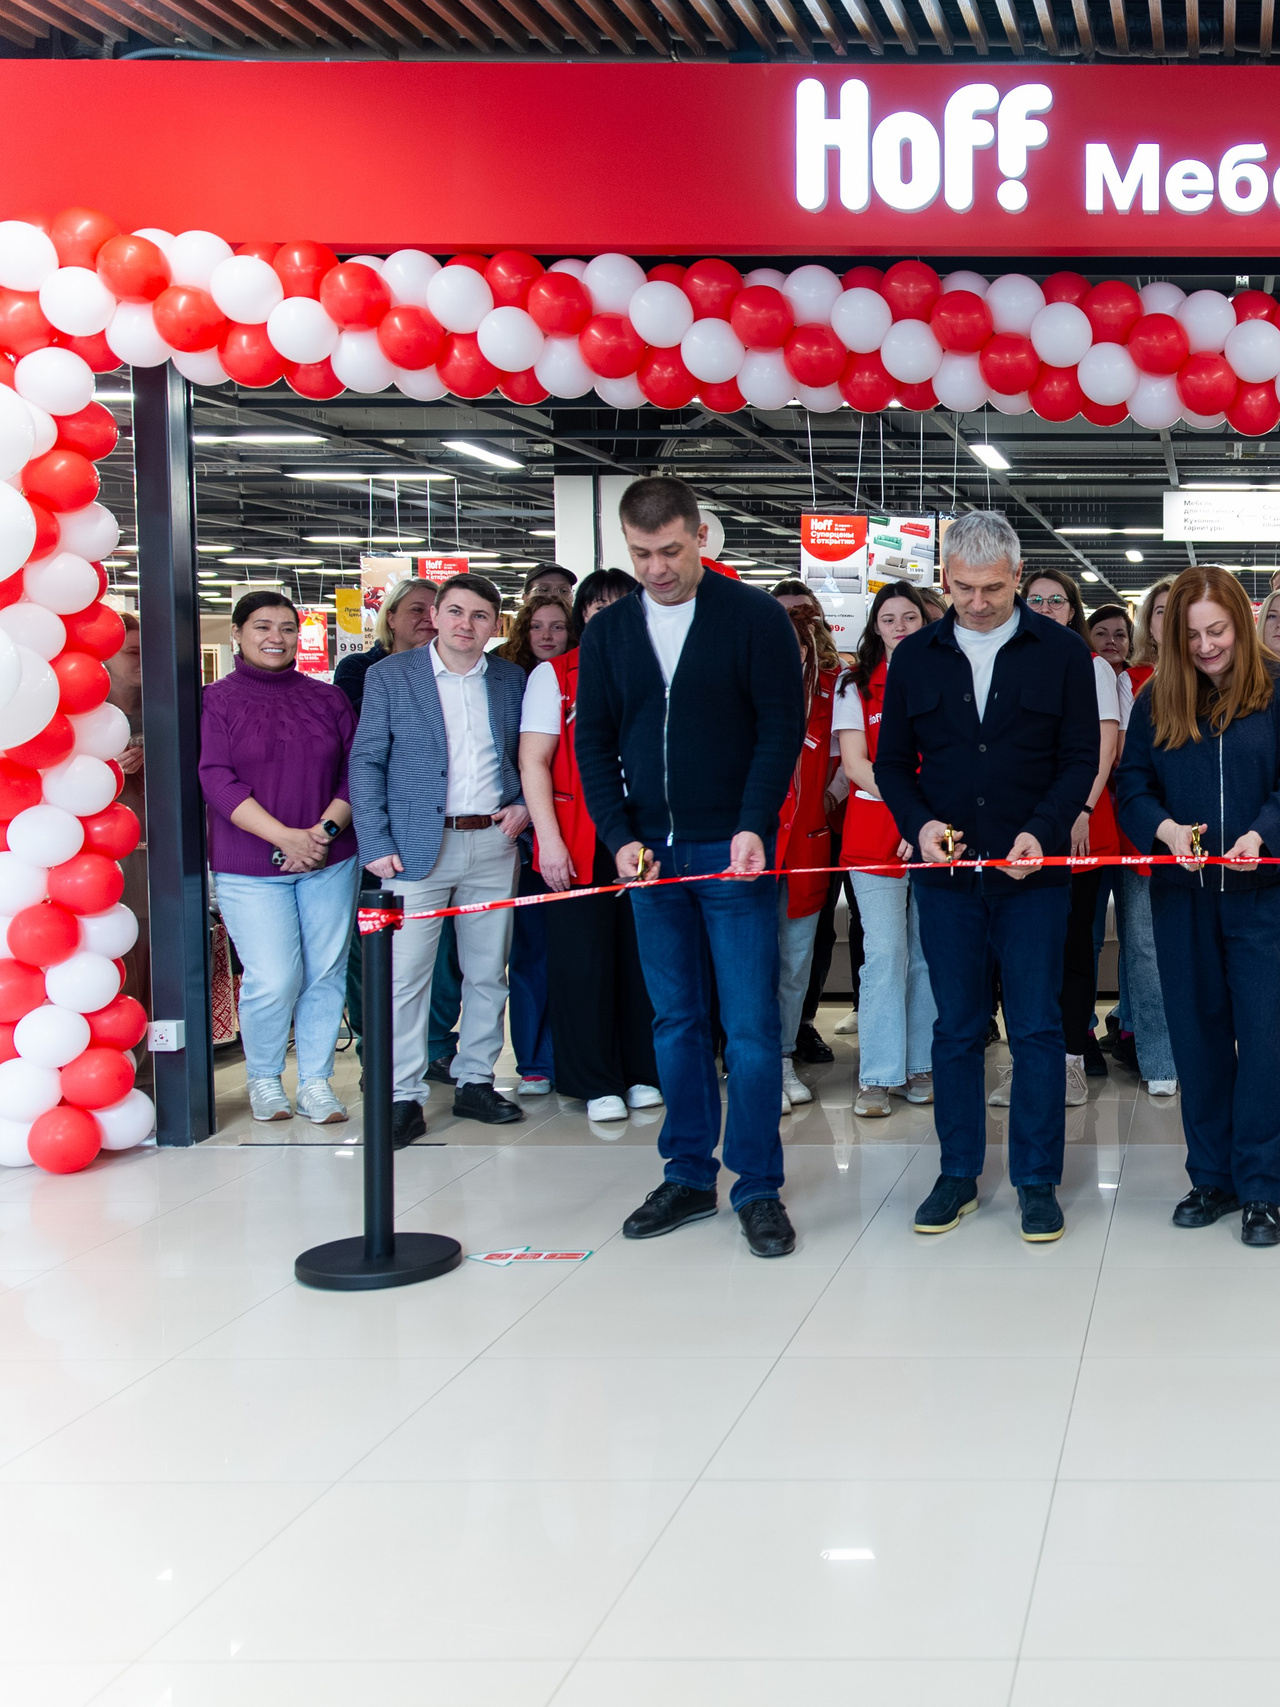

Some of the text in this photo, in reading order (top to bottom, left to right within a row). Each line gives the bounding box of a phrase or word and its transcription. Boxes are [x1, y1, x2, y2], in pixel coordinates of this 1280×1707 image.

[796, 77, 1053, 213] Hoff
[811, 519, 833, 530] Hoff
[811, 531, 854, 540] Суперцены
[425, 560, 443, 569] Hoff
[340, 643, 347, 652] 9
[1066, 857, 1099, 865] Hoff
